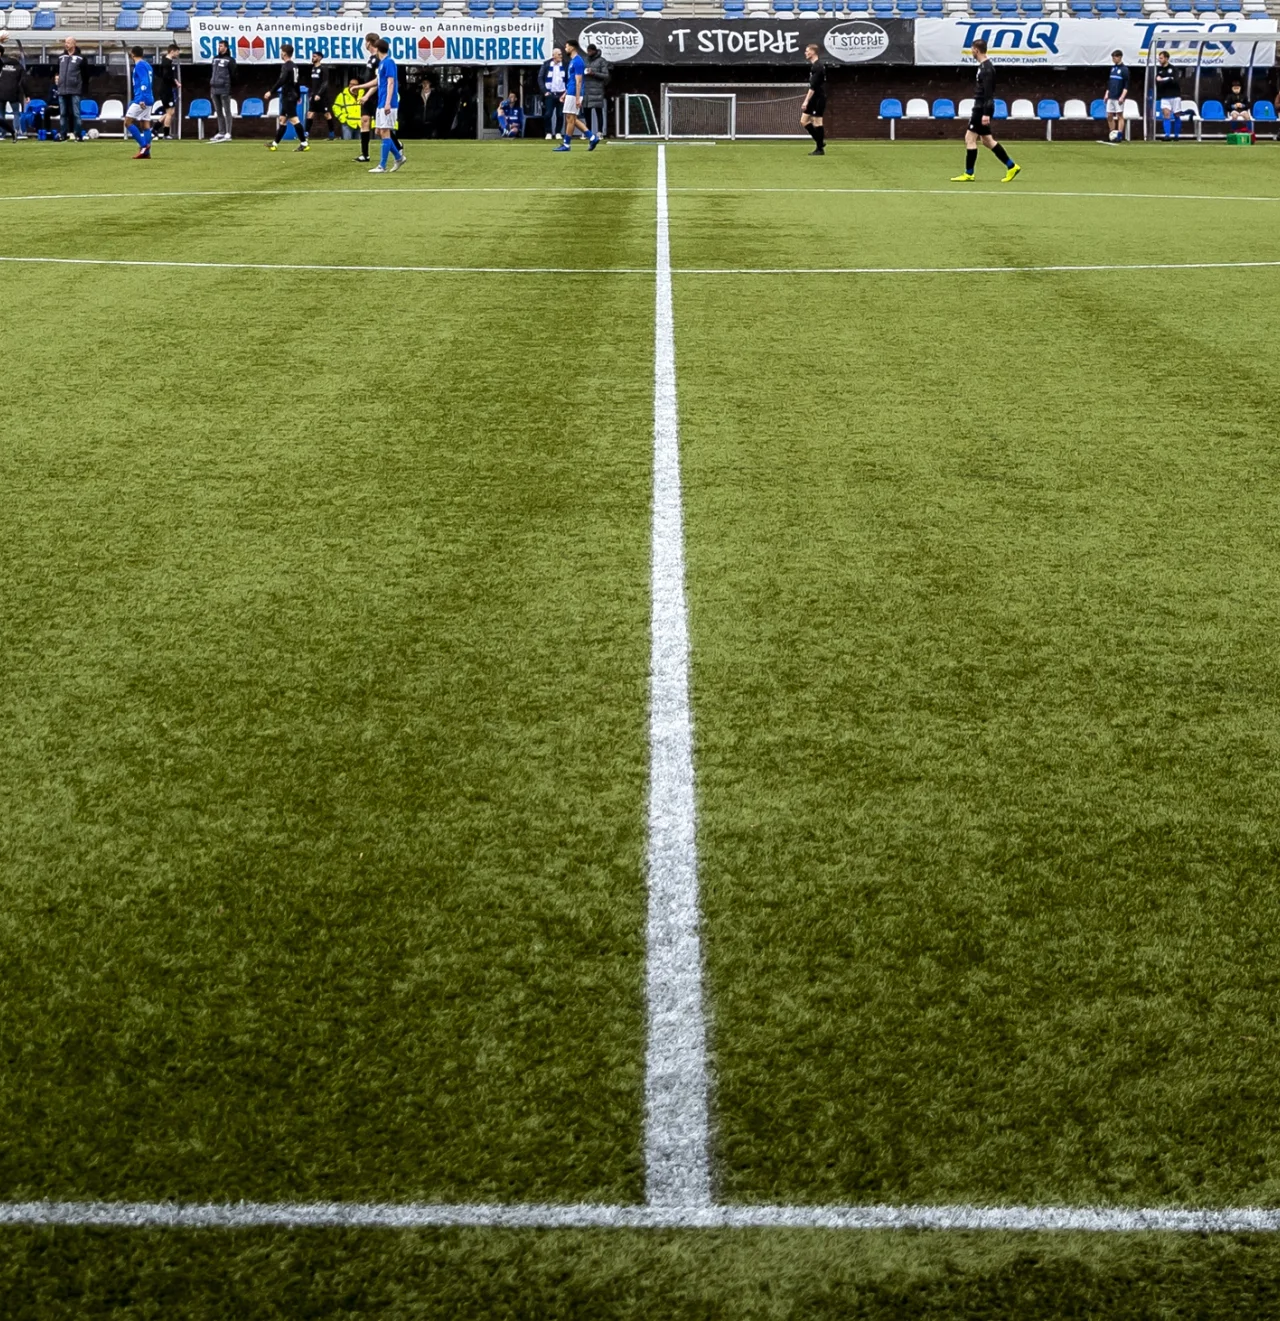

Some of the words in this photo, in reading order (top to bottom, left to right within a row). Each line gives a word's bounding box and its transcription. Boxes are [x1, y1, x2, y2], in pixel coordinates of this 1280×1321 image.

[199, 22, 234, 31] Bouw-
[239, 24, 252, 32] en
[256, 22, 363, 33] Aannemingsbedrijf
[380, 22, 415, 31] Bouw-
[420, 24, 433, 32] en
[437, 22, 544, 34] Aannemingsbedrijf
[697, 29, 800, 53] STOEPJE
[841, 35, 884, 46] STOEPJE
